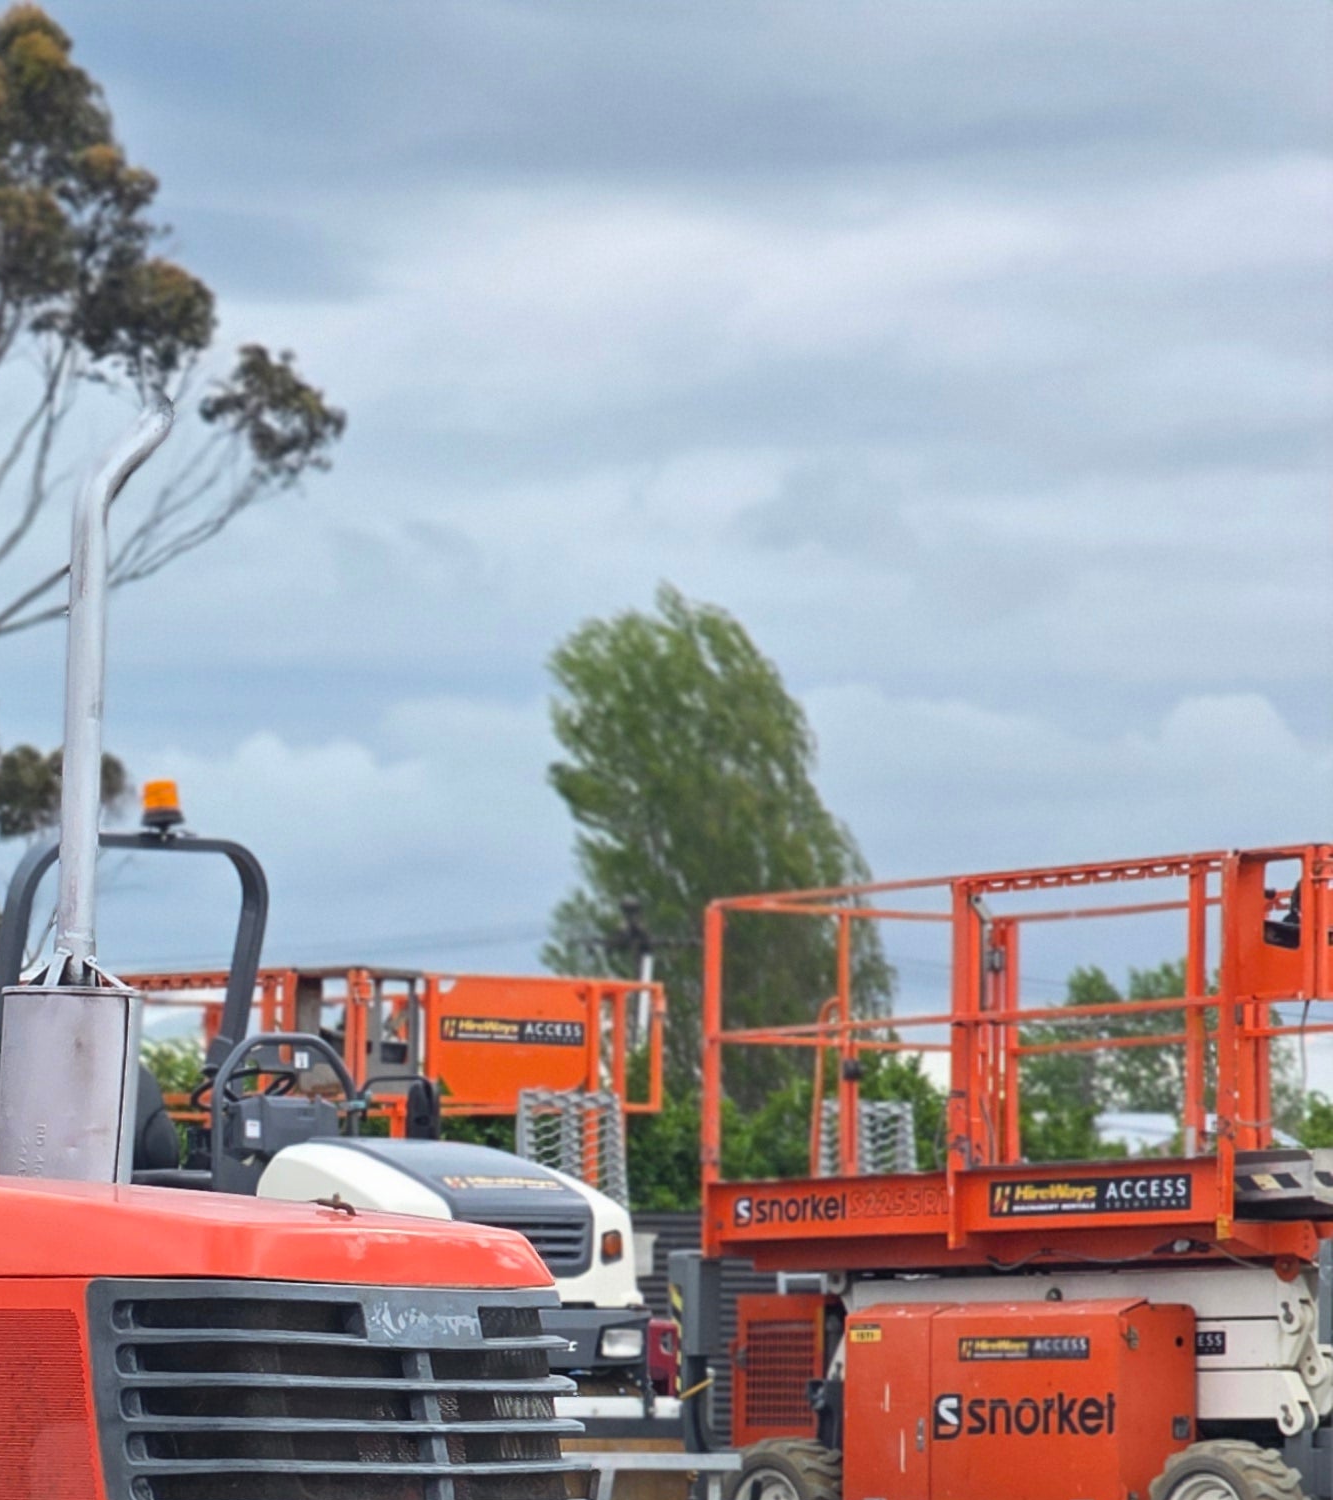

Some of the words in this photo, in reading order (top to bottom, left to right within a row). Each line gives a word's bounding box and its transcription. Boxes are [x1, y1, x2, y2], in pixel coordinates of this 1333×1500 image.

[525, 1022, 582, 1037] ACCESS
[1014, 1184, 1098, 1202] HireWays
[1105, 1177, 1187, 1200] ACCESS
[755, 1193, 847, 1223] snorkel
[1034, 1338, 1088, 1350] ACCESS
[1197, 1333, 1223, 1347] ESS
[966, 1391, 1116, 1437] snorkel
